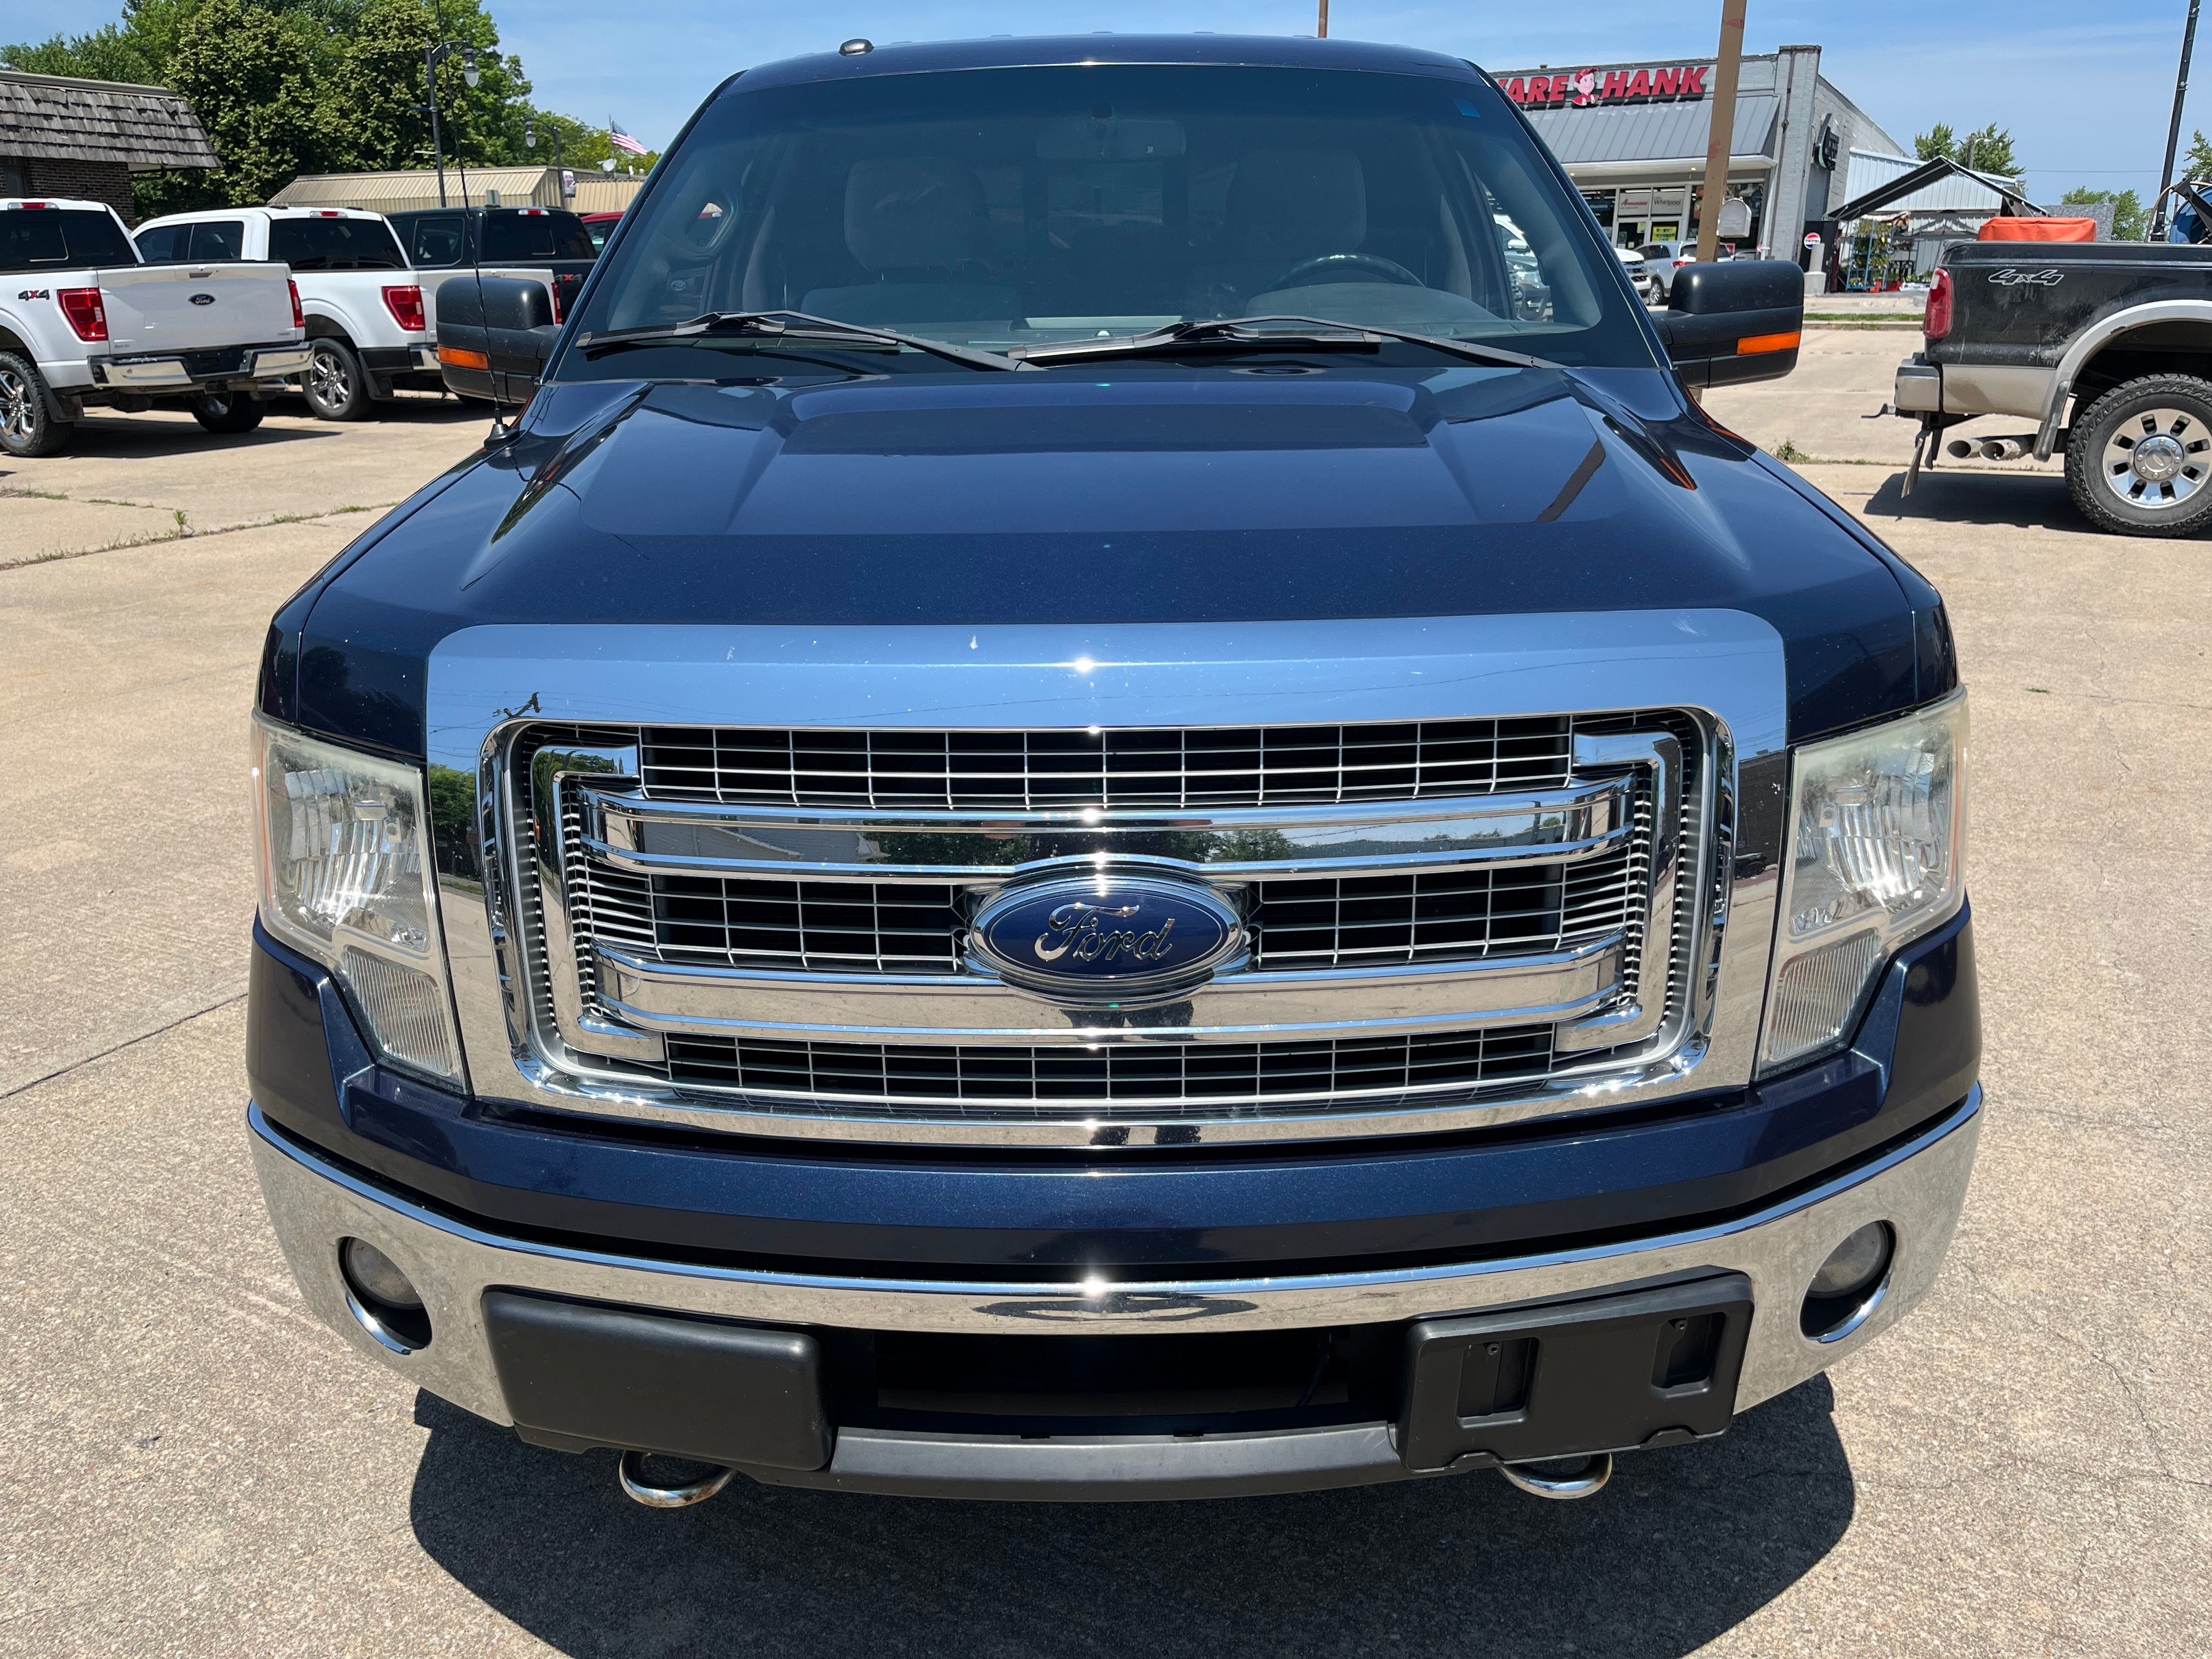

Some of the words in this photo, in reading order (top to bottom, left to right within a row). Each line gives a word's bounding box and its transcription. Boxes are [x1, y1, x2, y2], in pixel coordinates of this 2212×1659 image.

[1601, 66, 1709, 99] HANK
[1653, 197, 1682, 206] Whirlpool
[1988, 269, 2064, 285] 4x4
[195, 296, 211, 304] Ford
[1034, 902, 1176, 962] Ford
